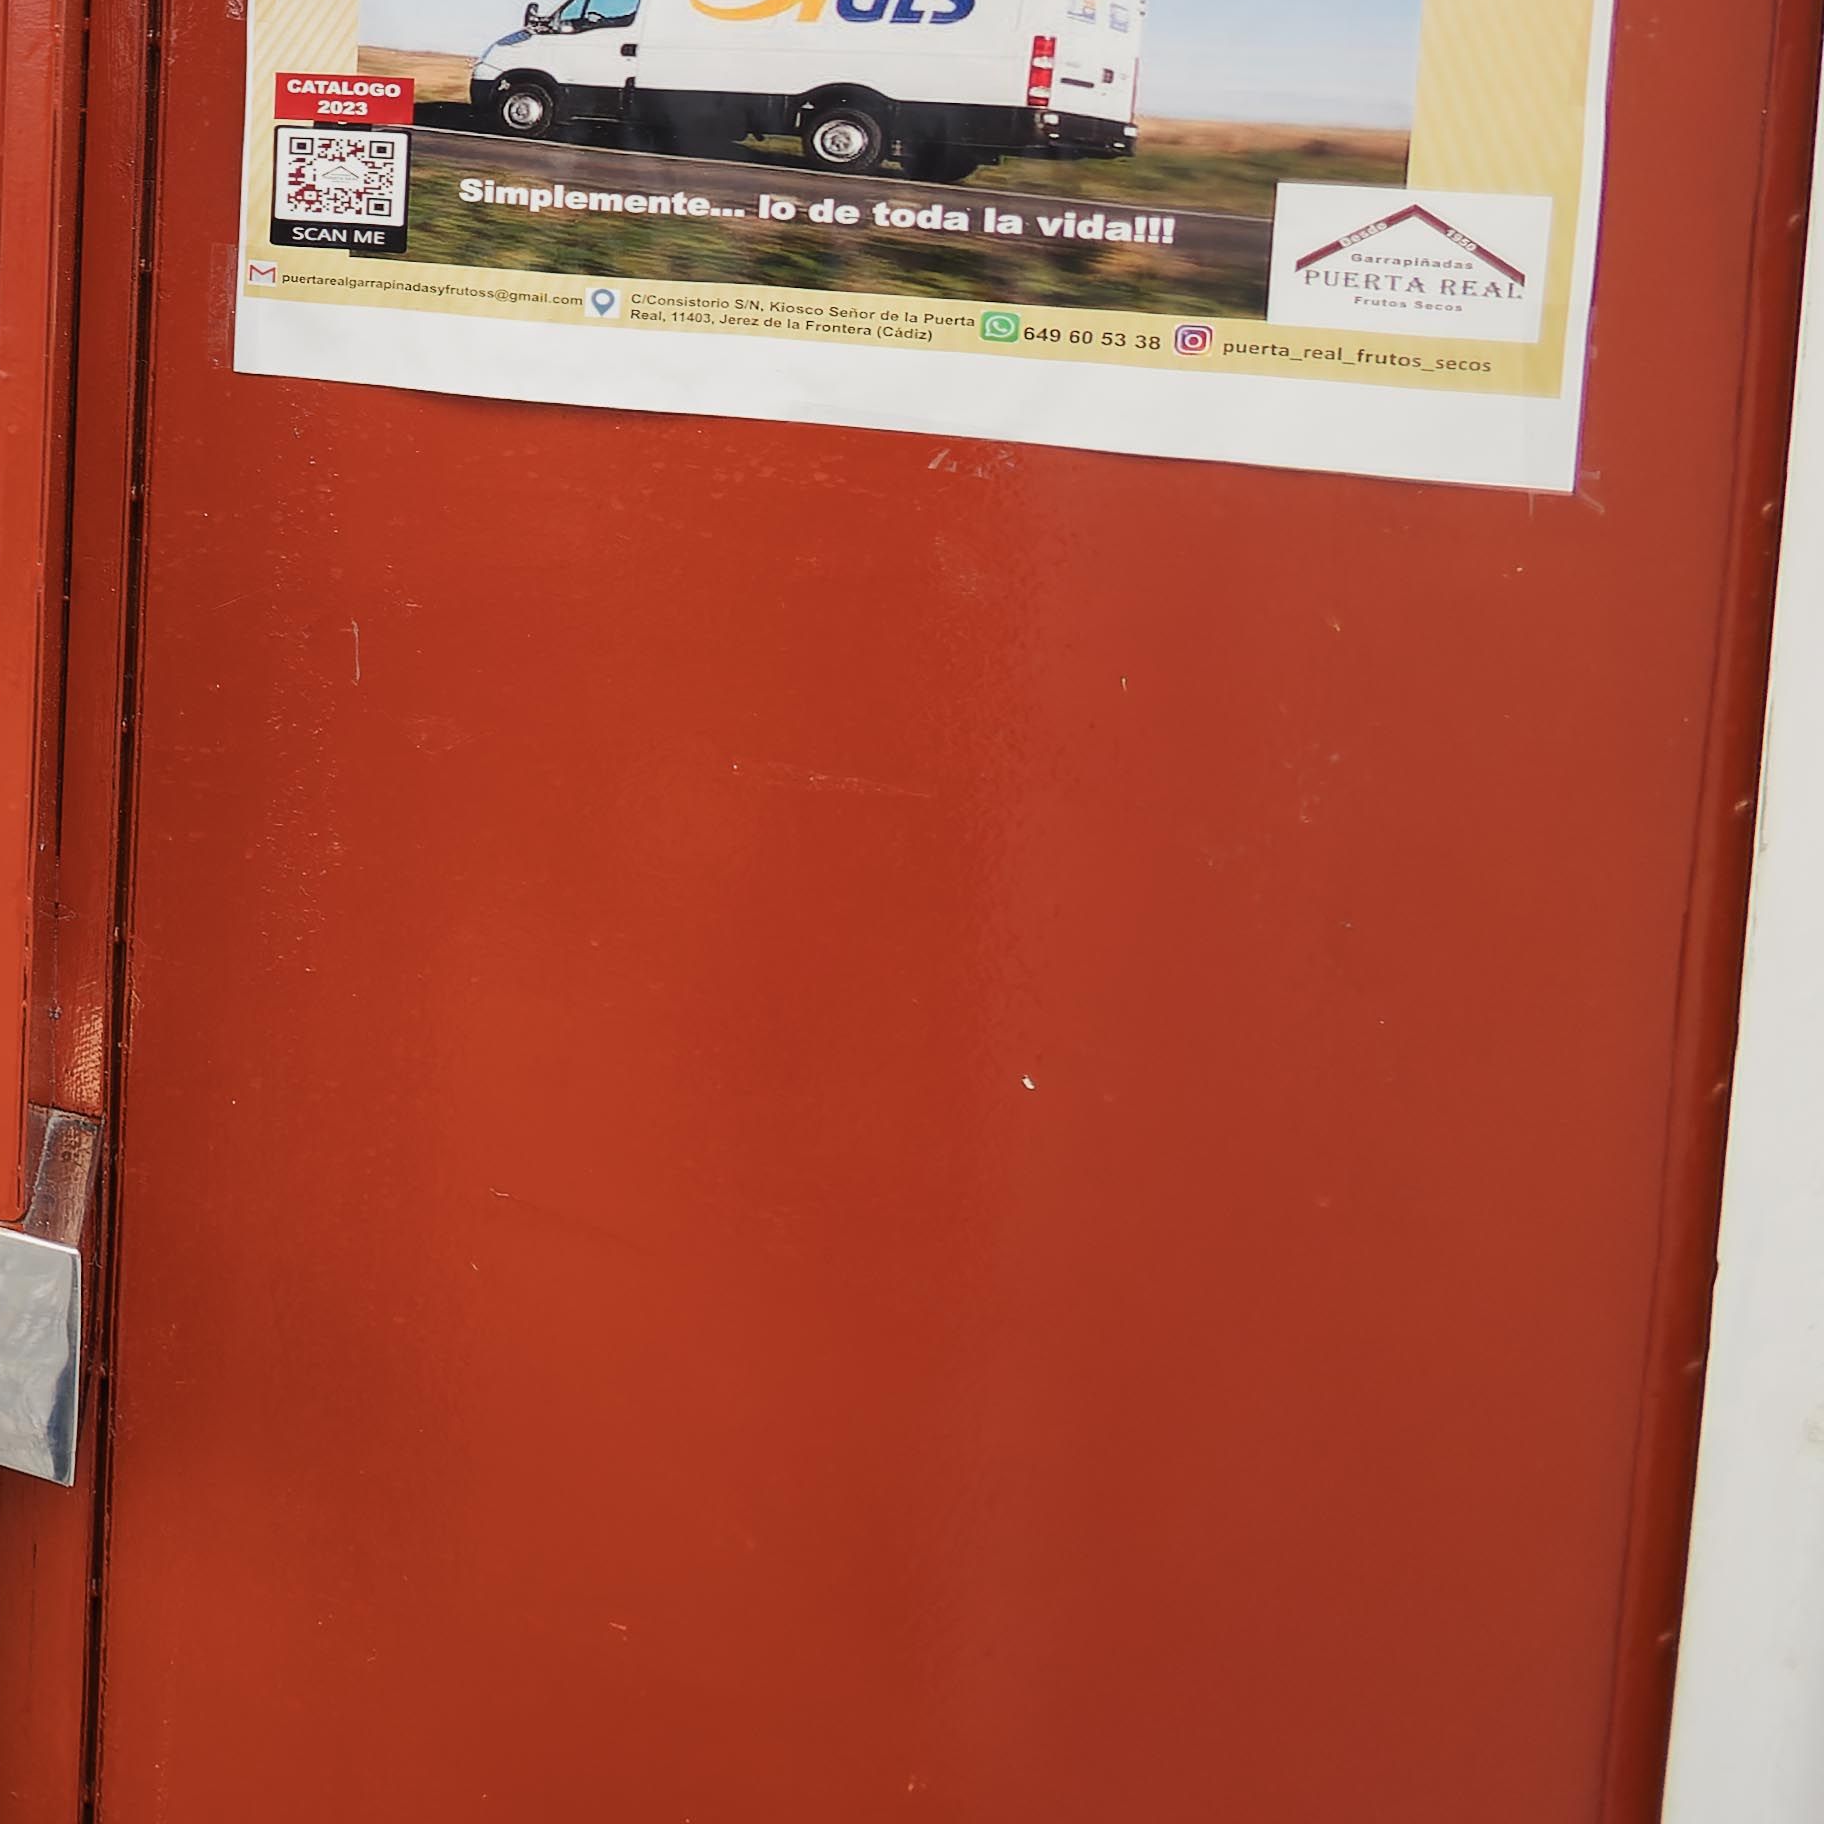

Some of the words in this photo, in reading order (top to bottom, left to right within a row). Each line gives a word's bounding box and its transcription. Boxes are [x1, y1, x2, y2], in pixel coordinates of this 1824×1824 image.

[287, 79, 401, 98] CATALOGO
[317, 100, 368, 116] 2023
[459, 178, 745, 218] Simplemente...
[759, 194, 796, 221] lo
[809, 198, 860, 226] de
[873, 201, 969, 232] toda
[983, 206, 1023, 235] la
[1036, 211, 1176, 245] vida!!!
[292, 226, 348, 243] SCAN
[353, 229, 385, 245] ME
[1351, 253, 1474, 270] Garrapiñadas
[281, 273, 583, 307] puertarealgarrapinadasyfrutoss@gmail.com
[1304, 268, 1425, 294] PUERTA
[1440, 278, 1523, 299] REAL
[631, 293, 730, 310] C/Consistorio
[734, 297, 765, 313] S/N,
[770, 301, 824, 317] Kiosco
[829, 304, 875, 321] Señor
[881, 309, 899, 323] de
[904, 311, 918, 325] la
[924, 313, 975, 328] Puerta
[1353, 295, 1407, 309] Frutos
[1414, 300, 1463, 312] Secos
[630, 308, 666, 324] Real,
[672, 311, 715, 327] 11403,
[719, 314, 759, 329] Jerez
[764, 316, 782, 330] de
[787, 318, 801, 331] la
[805, 319, 871, 337] Frontera
[876, 323, 933, 343] (Cádiz)
[1024, 326, 1061, 344] 649
[1069, 329, 1093, 345] 60
[1101, 331, 1126, 348] 53
[1135, 334, 1161, 351] 38
[1223, 338, 1492, 374] puerta_real_frutos_secos
